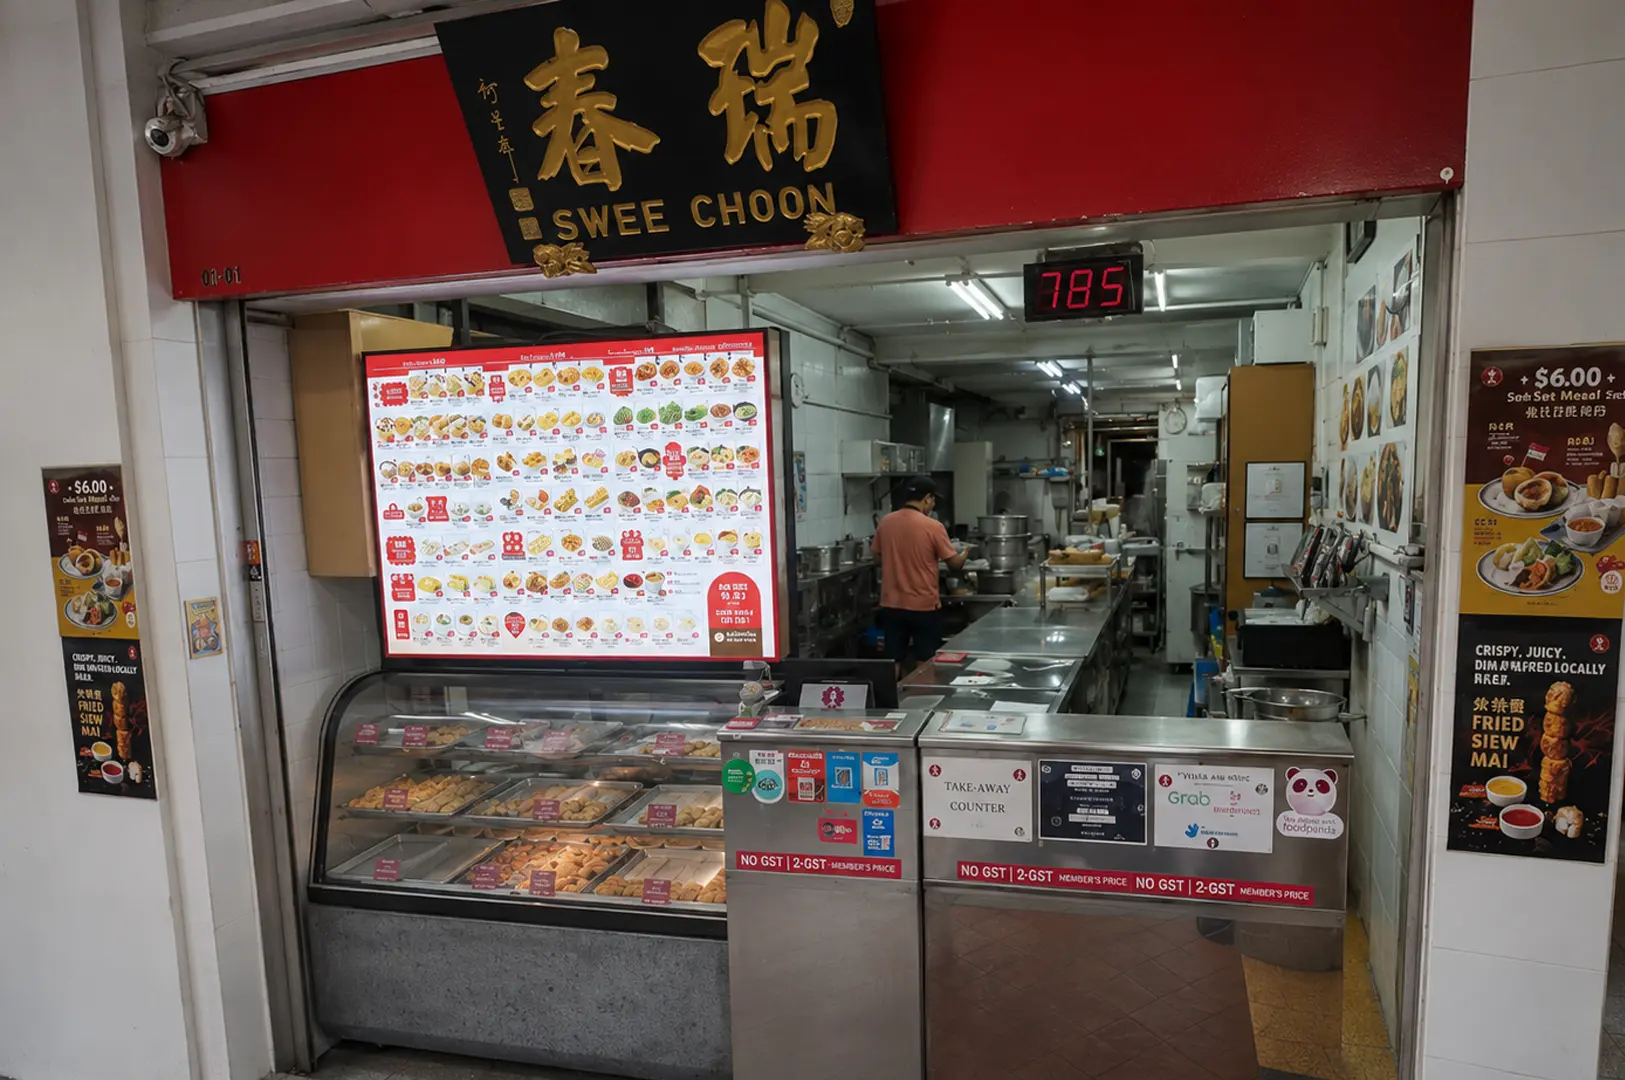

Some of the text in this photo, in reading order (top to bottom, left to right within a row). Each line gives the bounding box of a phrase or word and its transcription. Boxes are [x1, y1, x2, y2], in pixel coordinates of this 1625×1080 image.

[552, 182, 837, 241] SWEE CHOON
[1042, 266, 1125, 309] 785
[1534, 366, 1602, 389] $6.00
[1554, 661, 1606, 675] LOCALLY
[78, 700, 104, 713] FRIED
[80, 712, 103, 726] SIEW
[1472, 714, 1525, 732] FRIED
[1471, 733, 1520, 751] SIEW
[1470, 751, 1508, 769] MAI
[944, 781, 1011, 794] TAKE-AWAY
[949, 801, 1006, 813] COUNTER
[1168, 790, 1211, 806] Grab
[740, 854, 757, 866] NO
[760, 855, 784, 867] GST
[872, 864, 896, 874] PRICE
[961, 864, 979, 877] NO
[982, 866, 1007, 879] GST
[1102, 876, 1128, 887] PRICE
[1135, 876, 1154, 890] NO
[1158, 878, 1185, 891] GST
[1284, 890, 1310, 901] PRICE
